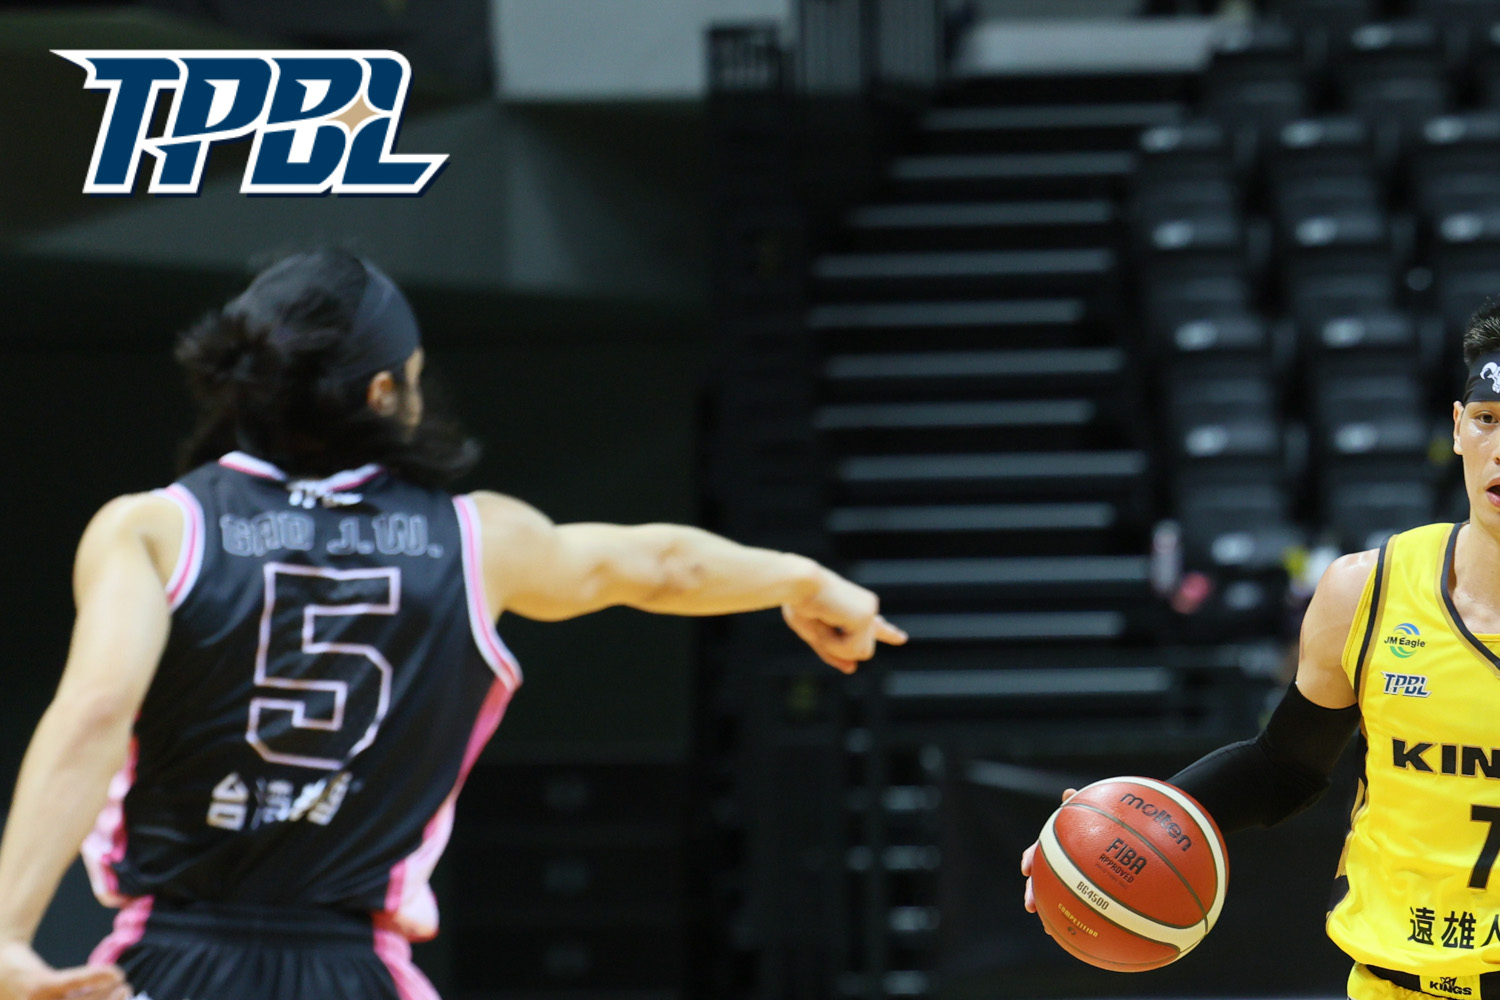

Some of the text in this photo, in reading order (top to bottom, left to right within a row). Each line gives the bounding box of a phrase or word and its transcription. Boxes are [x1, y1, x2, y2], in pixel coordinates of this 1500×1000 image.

[1384, 636, 1426, 648] JM Eagle
[246, 562, 401, 770] 5
[1380, 671, 1433, 698] TPBL
[1120, 793, 1193, 852] molten
[1099, 854, 1135, 883] APPROVED
[1106, 837, 1148, 875] FIBA
[1076, 881, 1110, 911] BG4500
[1429, 981, 1473, 996] KINGS
